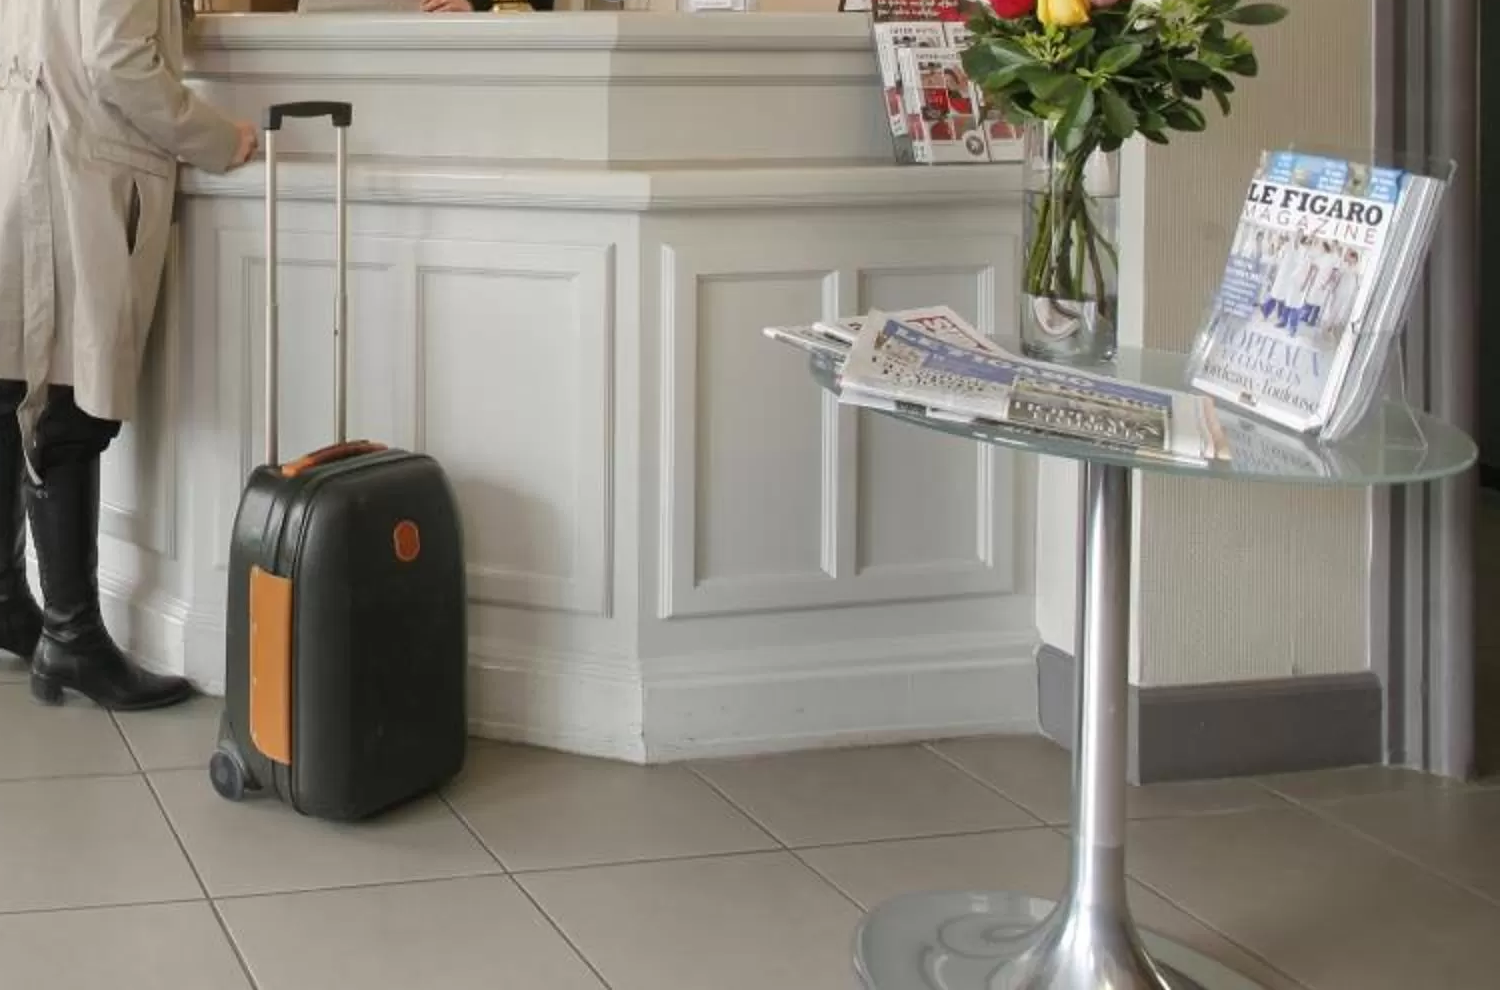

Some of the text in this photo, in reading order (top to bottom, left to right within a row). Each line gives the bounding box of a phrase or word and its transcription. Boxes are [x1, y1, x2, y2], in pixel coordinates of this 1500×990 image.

[1244, 205, 1379, 246] MAGAZINE
[1247, 182, 1384, 227] LE FIGARO
